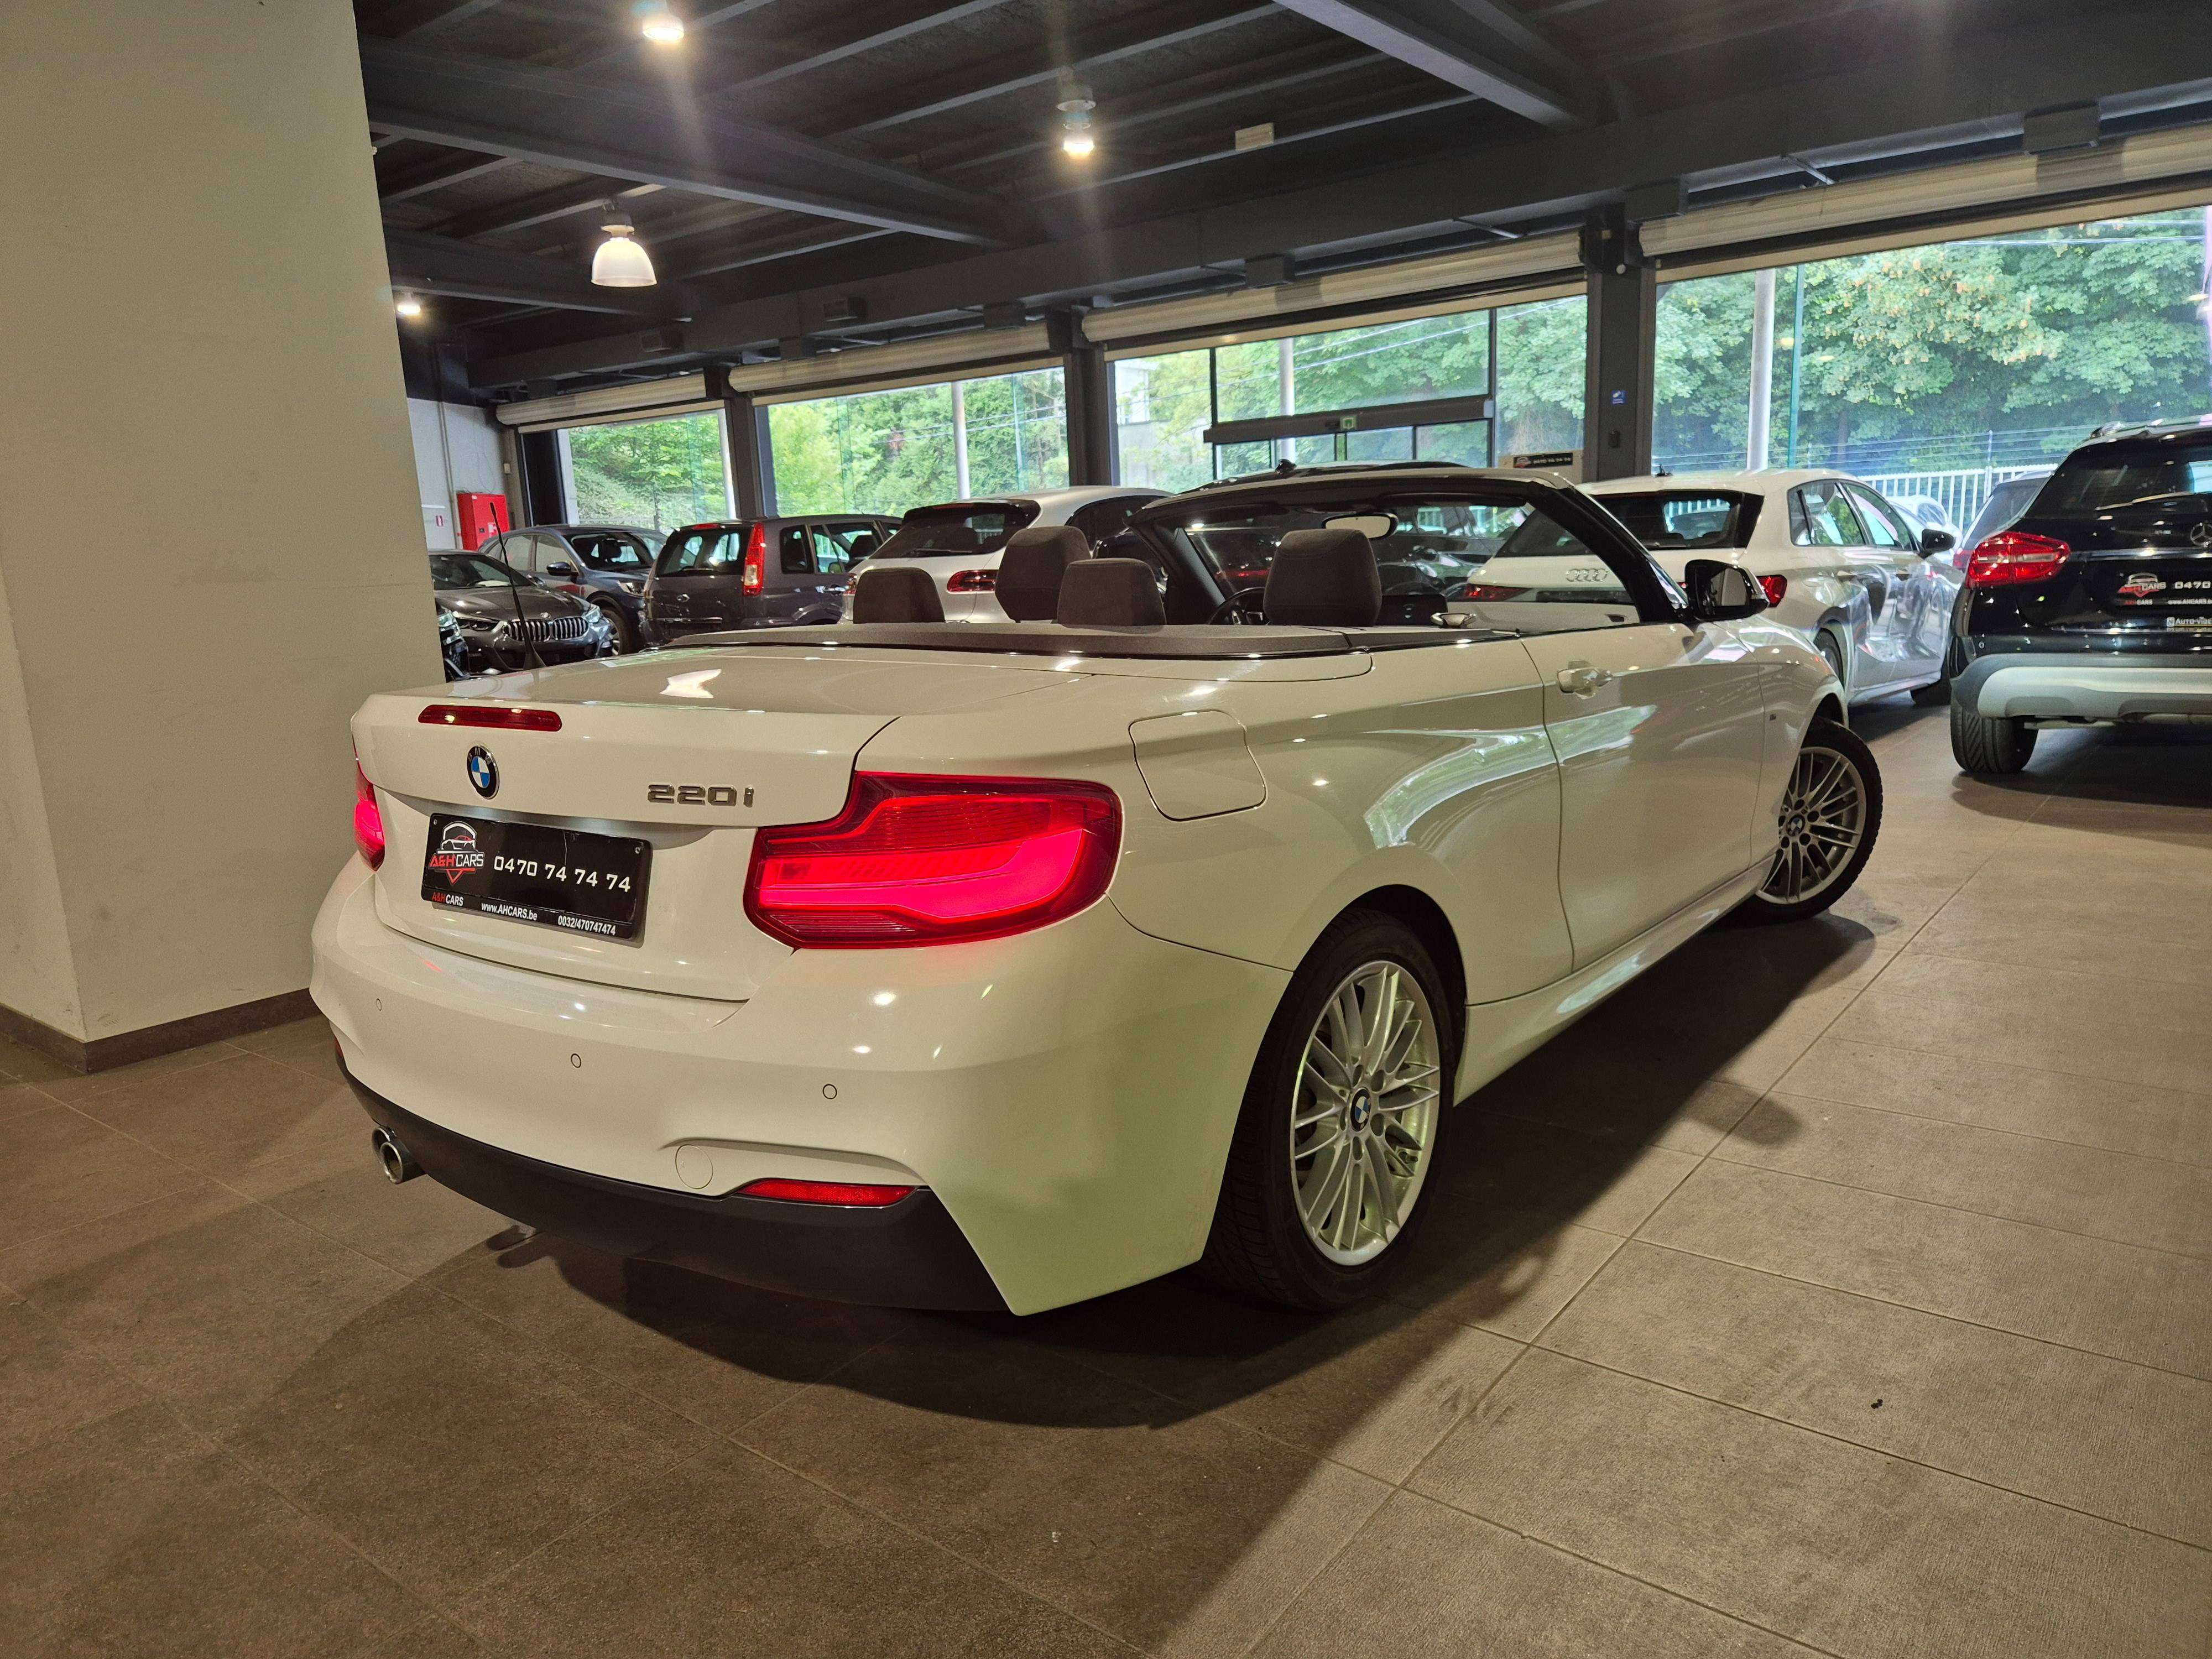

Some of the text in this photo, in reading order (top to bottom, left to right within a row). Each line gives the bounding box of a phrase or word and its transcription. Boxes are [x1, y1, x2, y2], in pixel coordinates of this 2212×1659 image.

[494, 855, 631, 893] 0470 74 74 74
[481, 902, 538, 921] www.AHCARS.be
[557, 915, 616, 936] 0032/470747474
